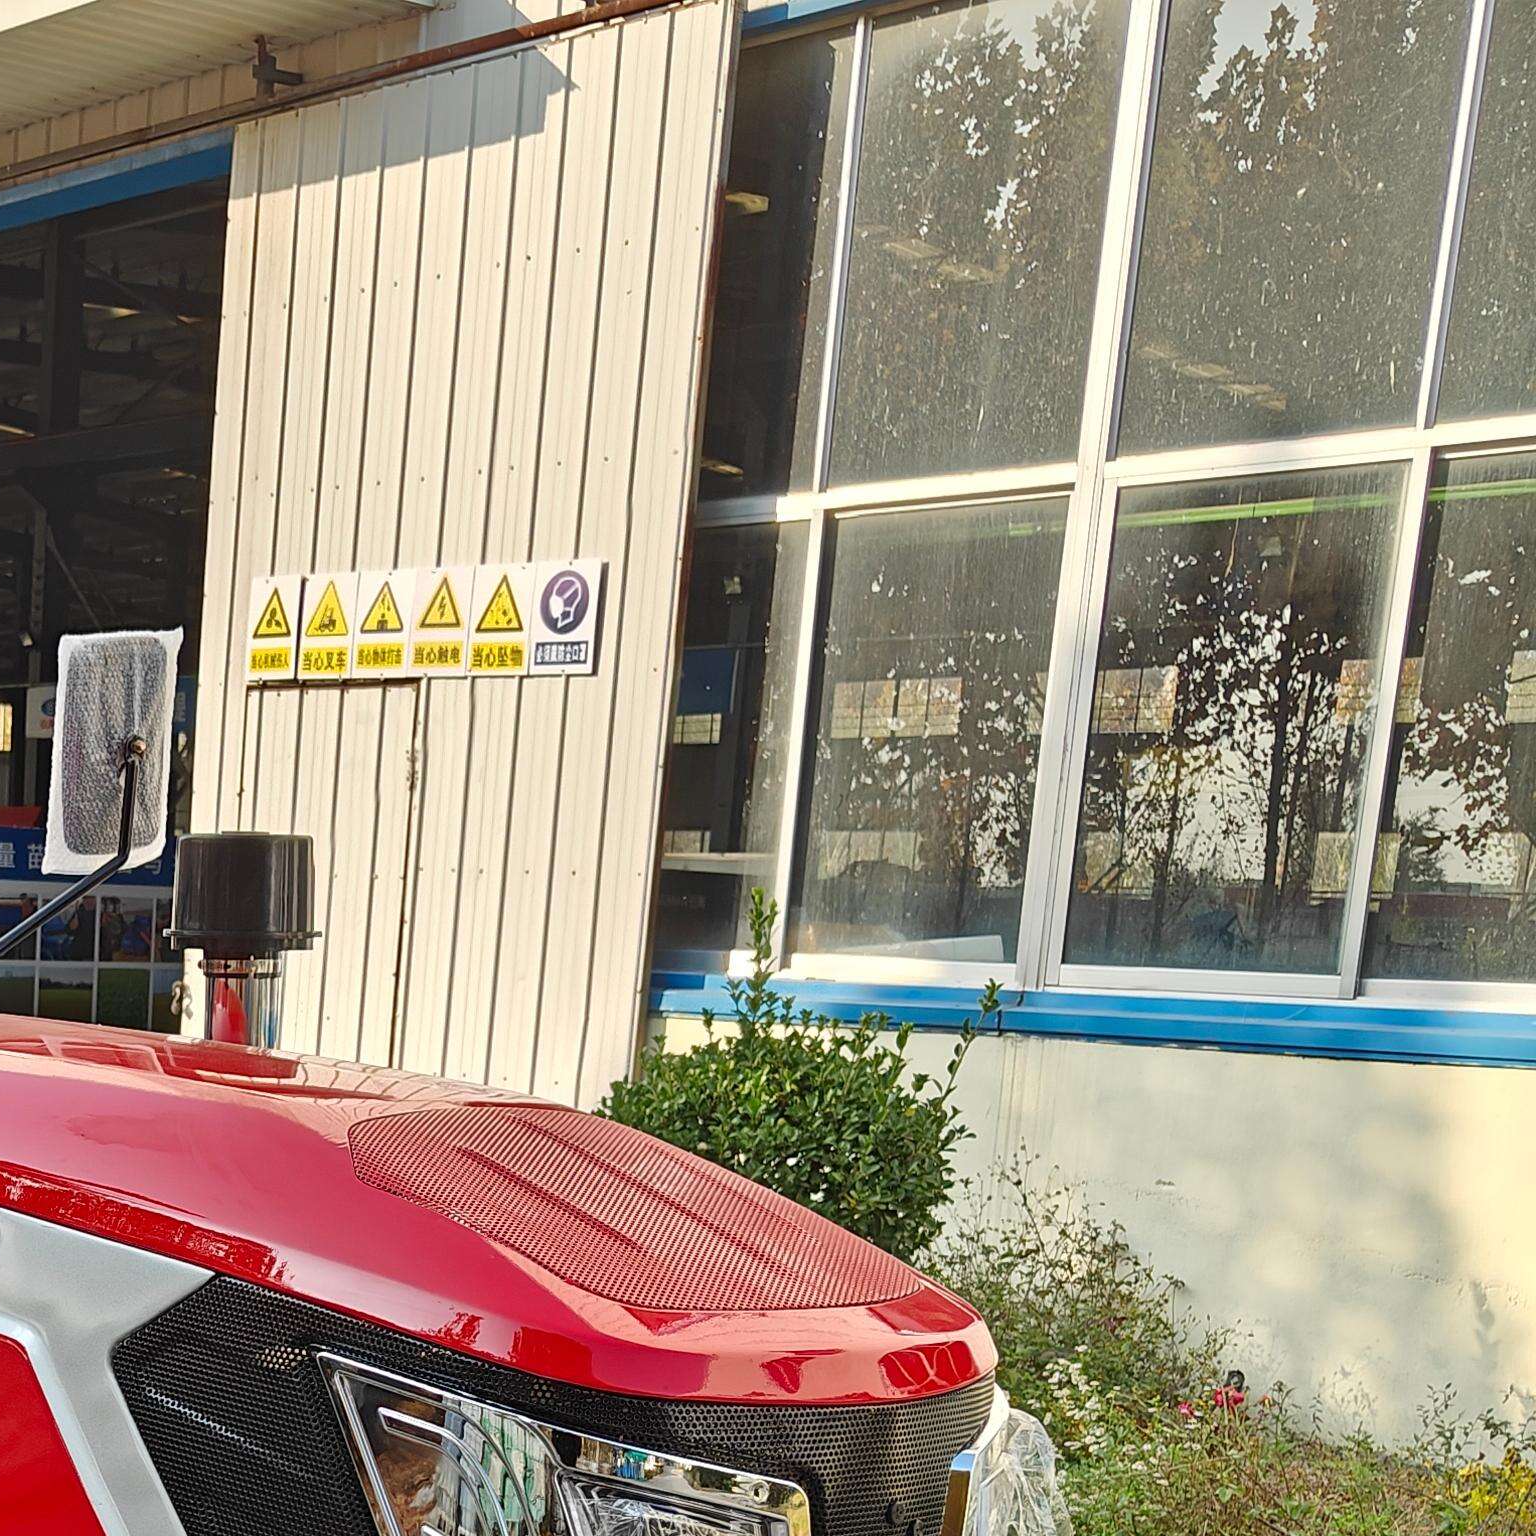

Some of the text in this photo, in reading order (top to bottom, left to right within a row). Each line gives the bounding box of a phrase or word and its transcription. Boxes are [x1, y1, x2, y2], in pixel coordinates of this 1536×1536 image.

[302, 650, 347, 672] 当心叉车
[412, 645, 462, 665] 当心触电
[471, 645, 523, 668] 当心坠物
